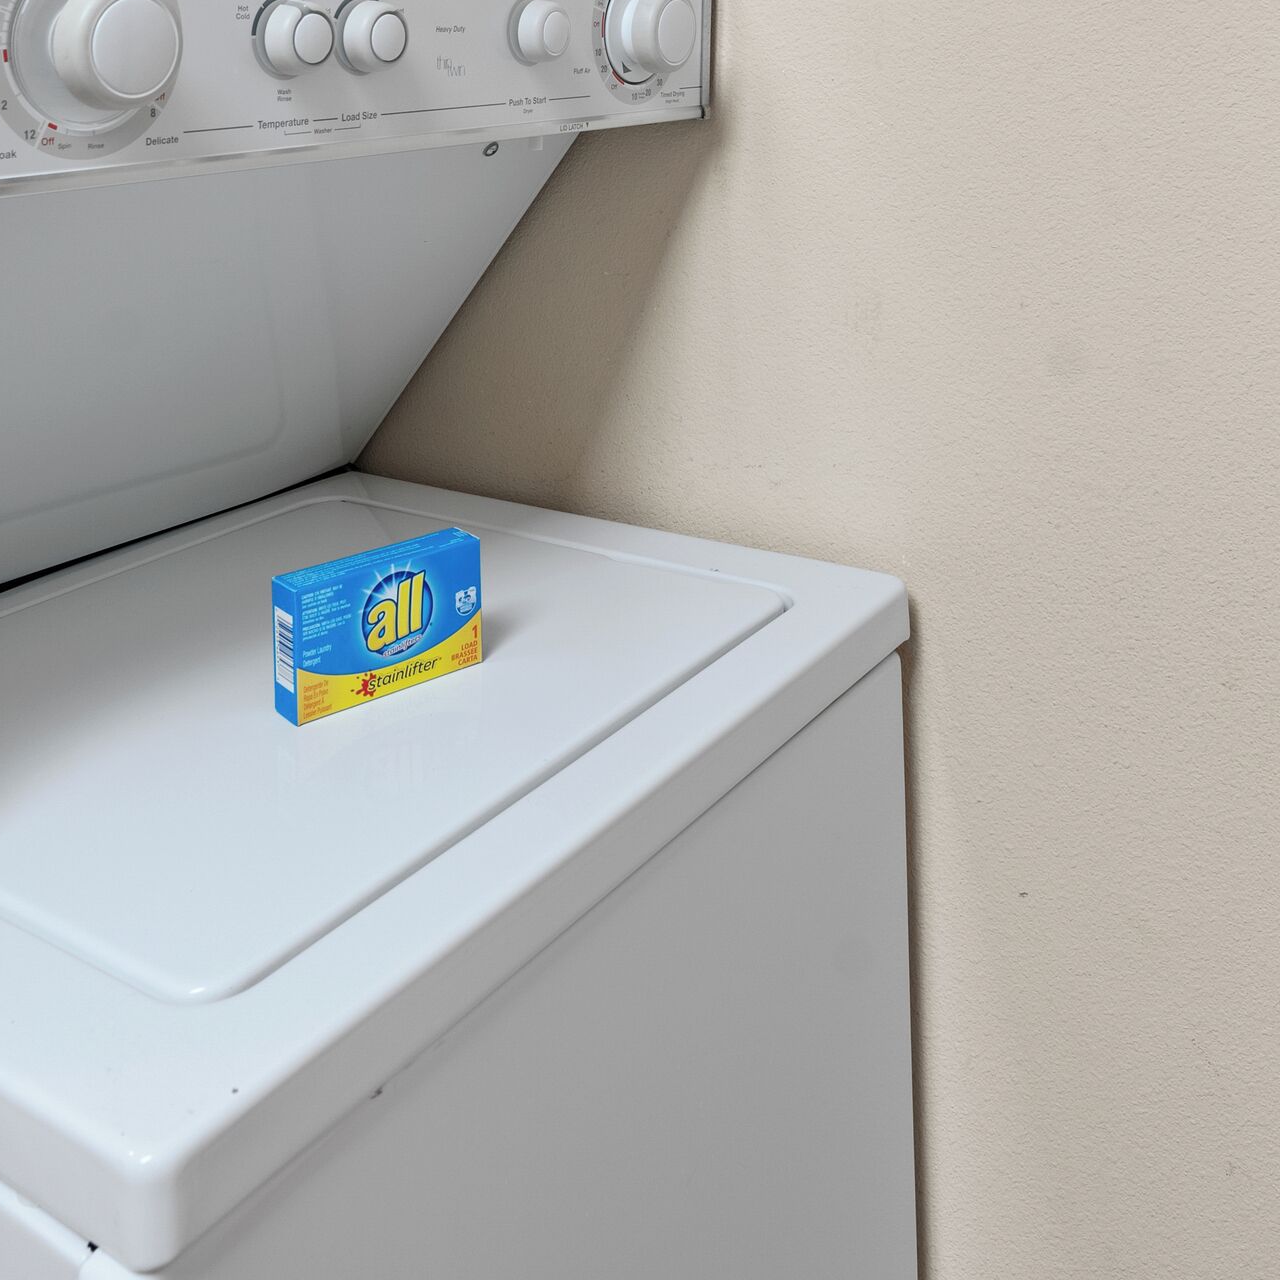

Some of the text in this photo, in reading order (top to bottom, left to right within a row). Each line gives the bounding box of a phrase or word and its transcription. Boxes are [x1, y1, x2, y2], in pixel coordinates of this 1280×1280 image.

[601, 65, 608, 73] 20
[1, 100, 8, 110] 2
[509, 97, 547, 106] Push To Start
[150, 108, 156, 118] 8
[341, 111, 377, 122] Load Size
[258, 118, 309, 129] Temperature
[24, 129, 36, 140] 12
[41, 137, 55, 146] Off
[145, 136, 179, 146] Delicate
[366, 569, 426, 652] all
[472, 624, 478, 639] 1
[461, 640, 478, 651] LOAD
